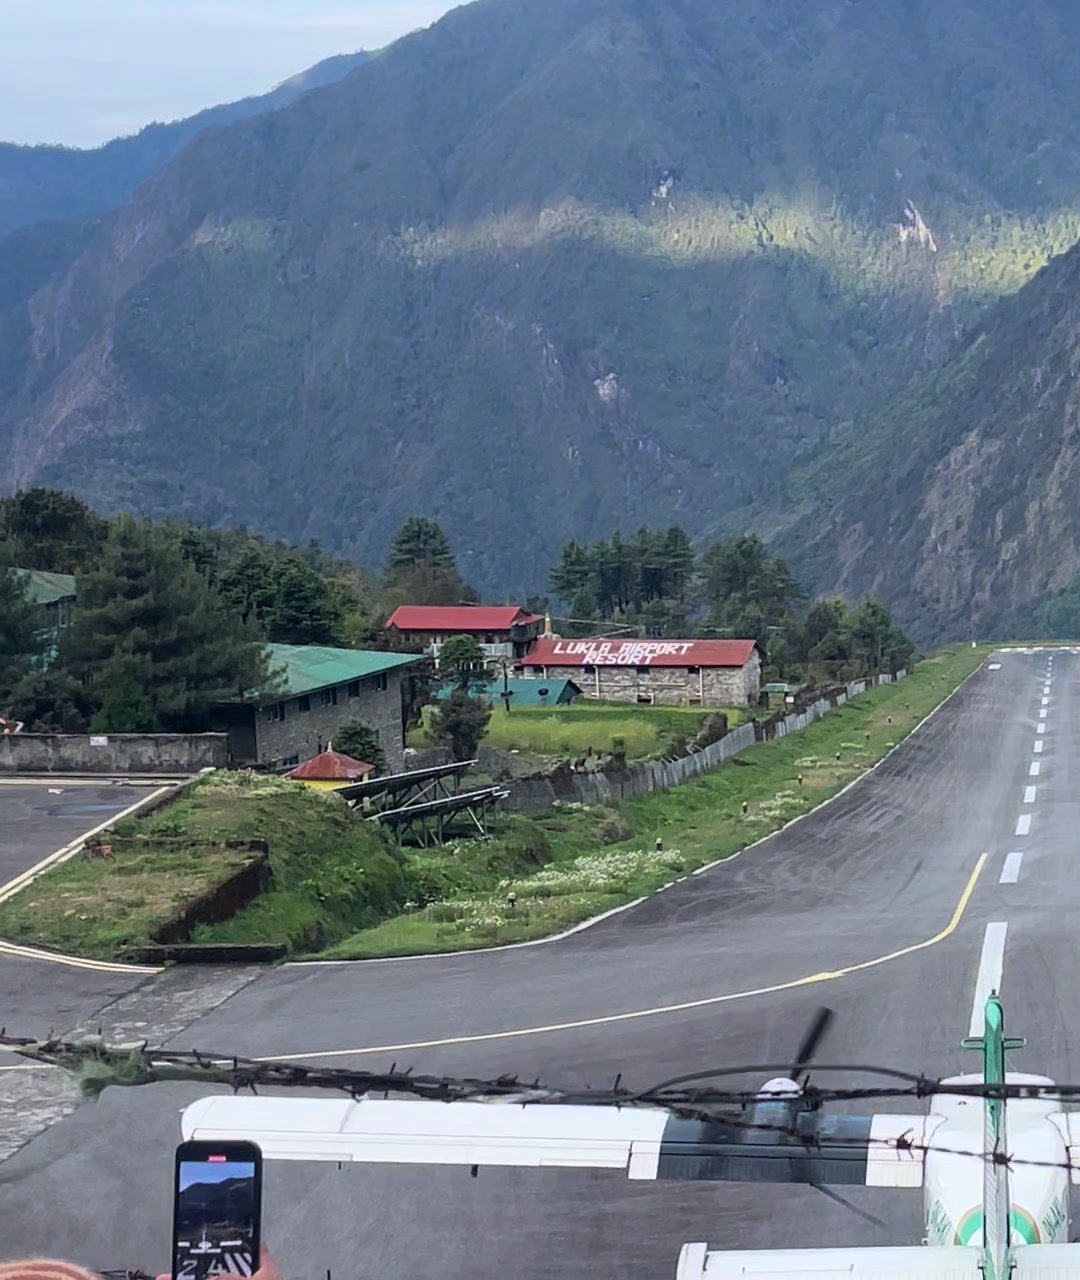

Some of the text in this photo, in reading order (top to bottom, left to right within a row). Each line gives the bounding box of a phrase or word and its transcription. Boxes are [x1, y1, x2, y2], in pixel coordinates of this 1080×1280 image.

[553, 642, 694, 655] LUKLA AIRPORT
[582, 652, 657, 665] RESORT
